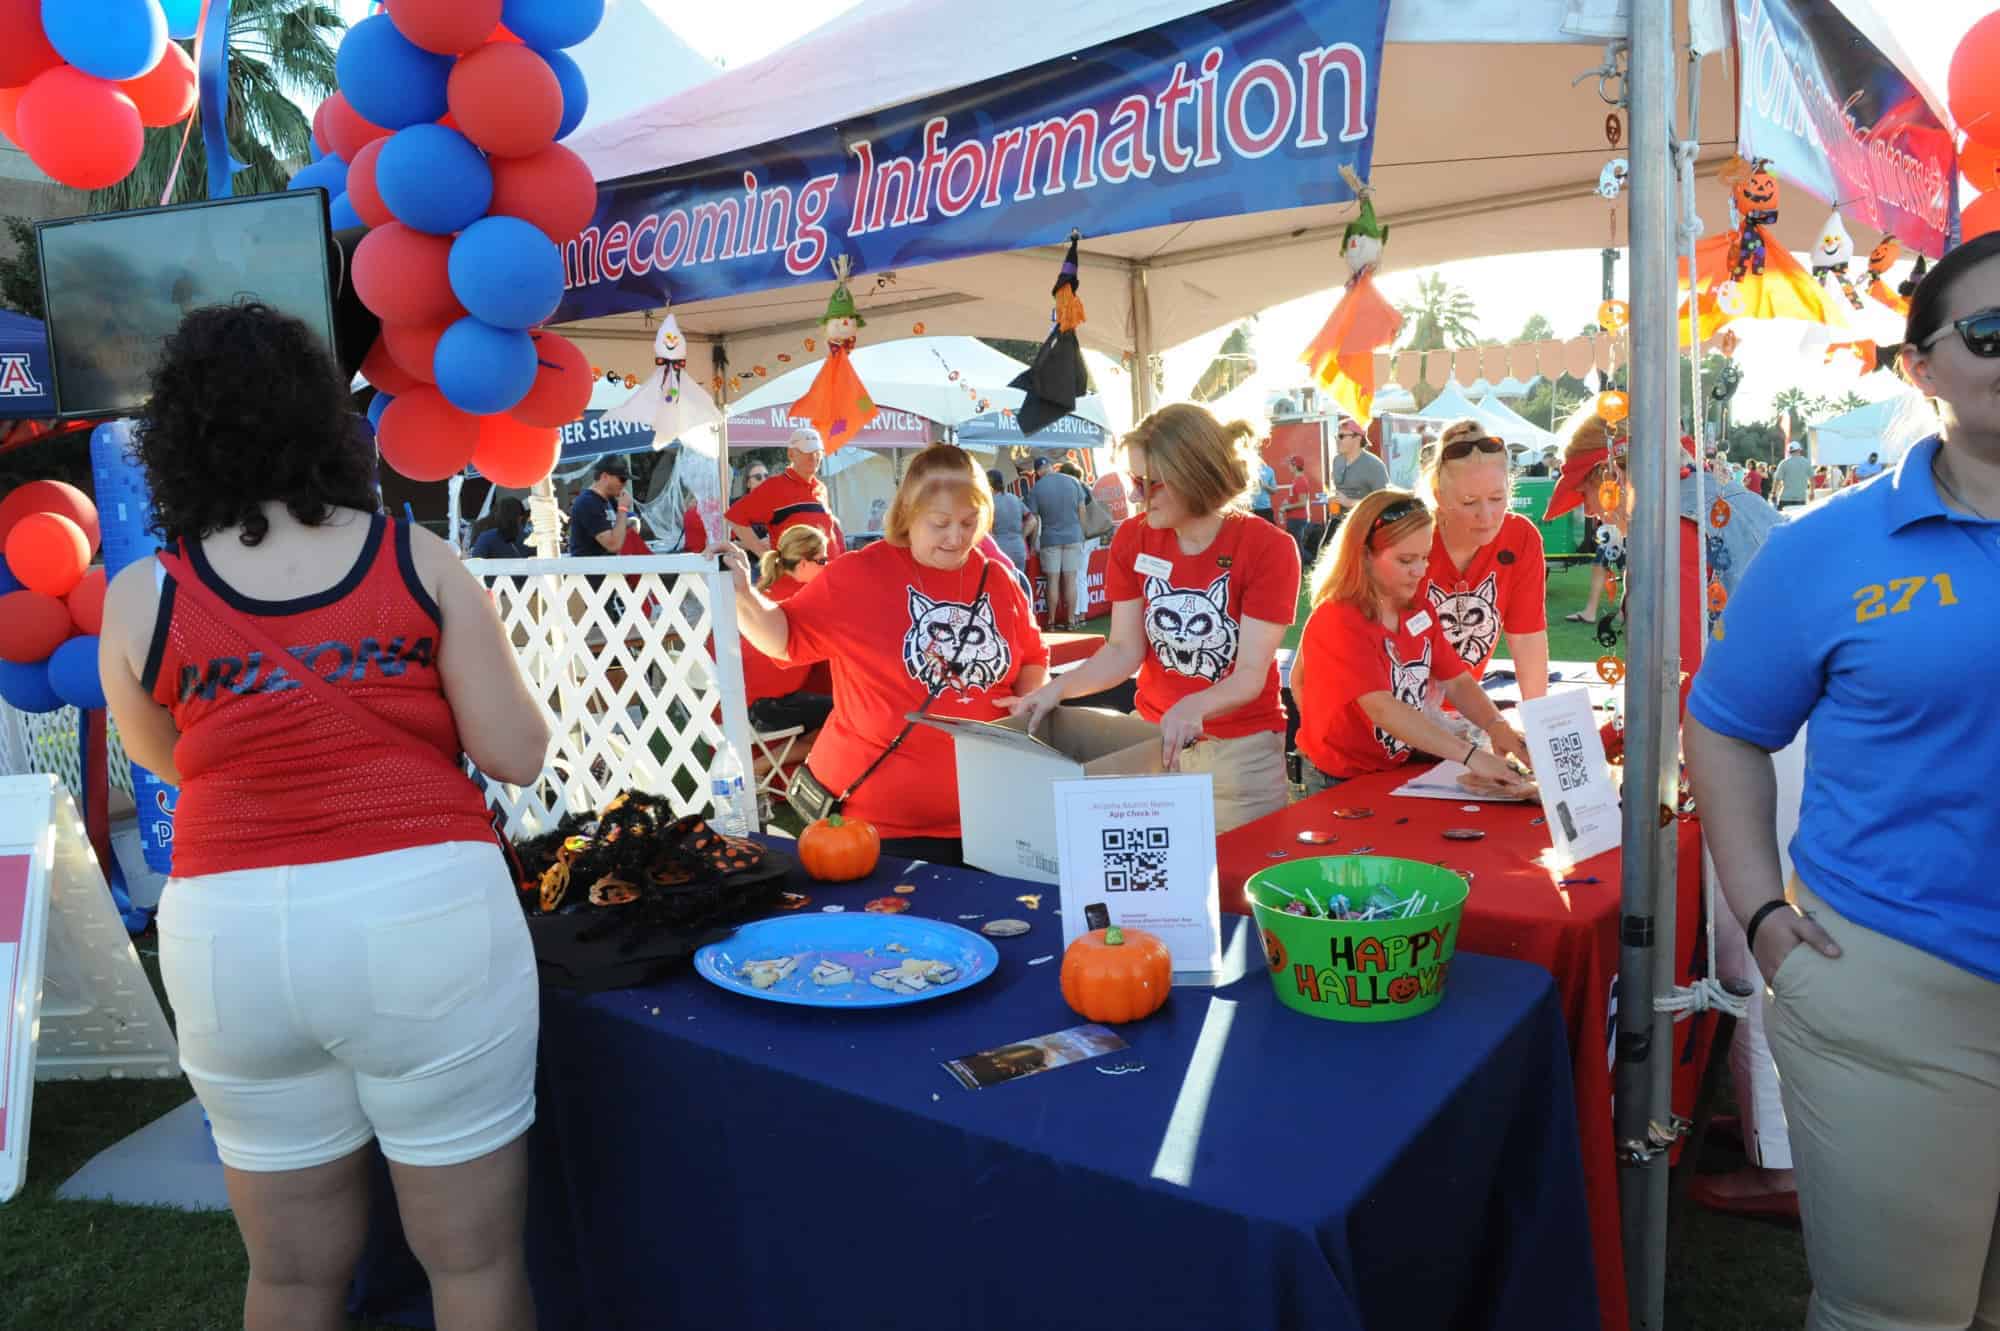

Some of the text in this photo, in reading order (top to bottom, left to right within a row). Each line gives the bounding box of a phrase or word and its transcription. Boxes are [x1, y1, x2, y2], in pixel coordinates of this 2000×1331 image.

[560, 41, 1369, 290] mecoming Information
[1853, 574, 1959, 624] 271
[1330, 922, 1452, 973] HAPPY
